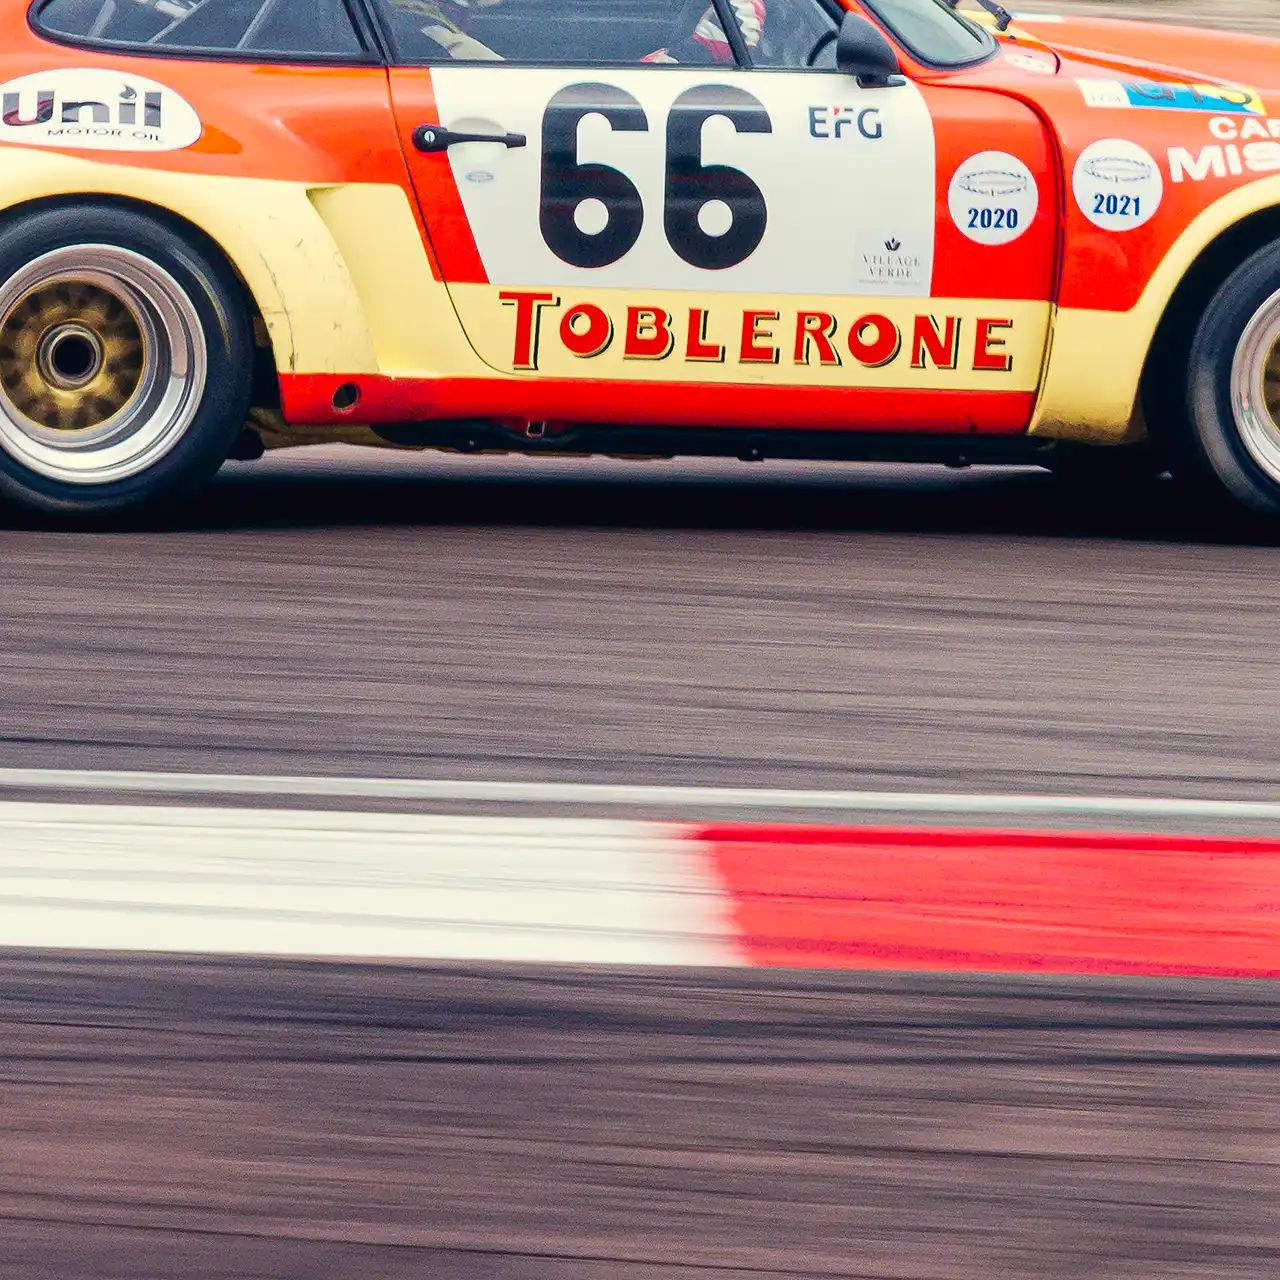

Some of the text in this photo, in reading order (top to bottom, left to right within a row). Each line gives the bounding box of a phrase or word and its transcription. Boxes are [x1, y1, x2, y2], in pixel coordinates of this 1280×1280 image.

[2, 83, 163, 128] Unil
[47, 127, 164, 142] MOTOR OIL
[808, 106, 882, 139] EFG
[539, 81, 772, 270] 66
[968, 208, 1018, 229] 2020
[1093, 193, 1140, 216] 2021
[499, 291, 1013, 371] TOBLERONE
